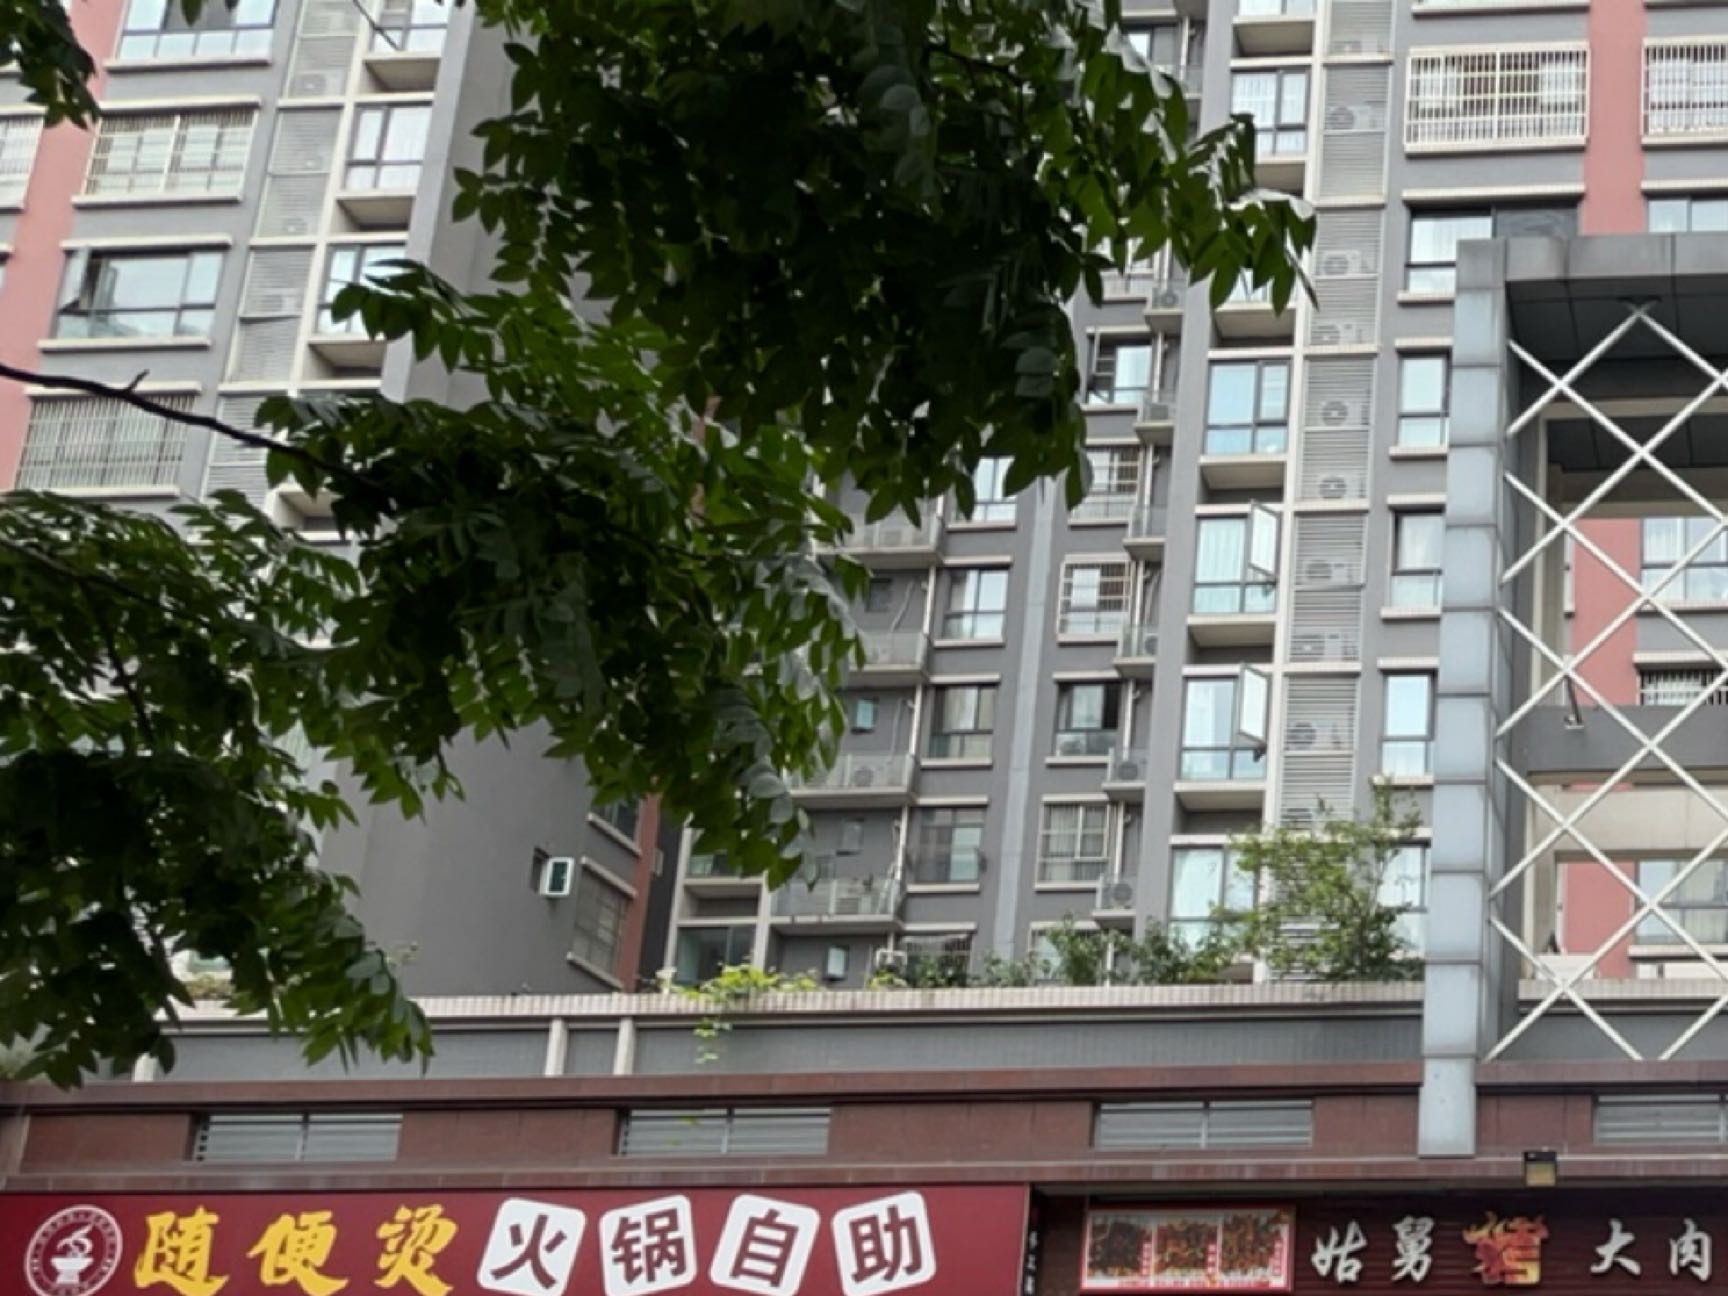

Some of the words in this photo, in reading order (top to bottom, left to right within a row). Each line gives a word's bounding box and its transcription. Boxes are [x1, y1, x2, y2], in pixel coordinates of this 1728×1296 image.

[1311, 1211, 1712, 1284] 姑舅烤大肉
